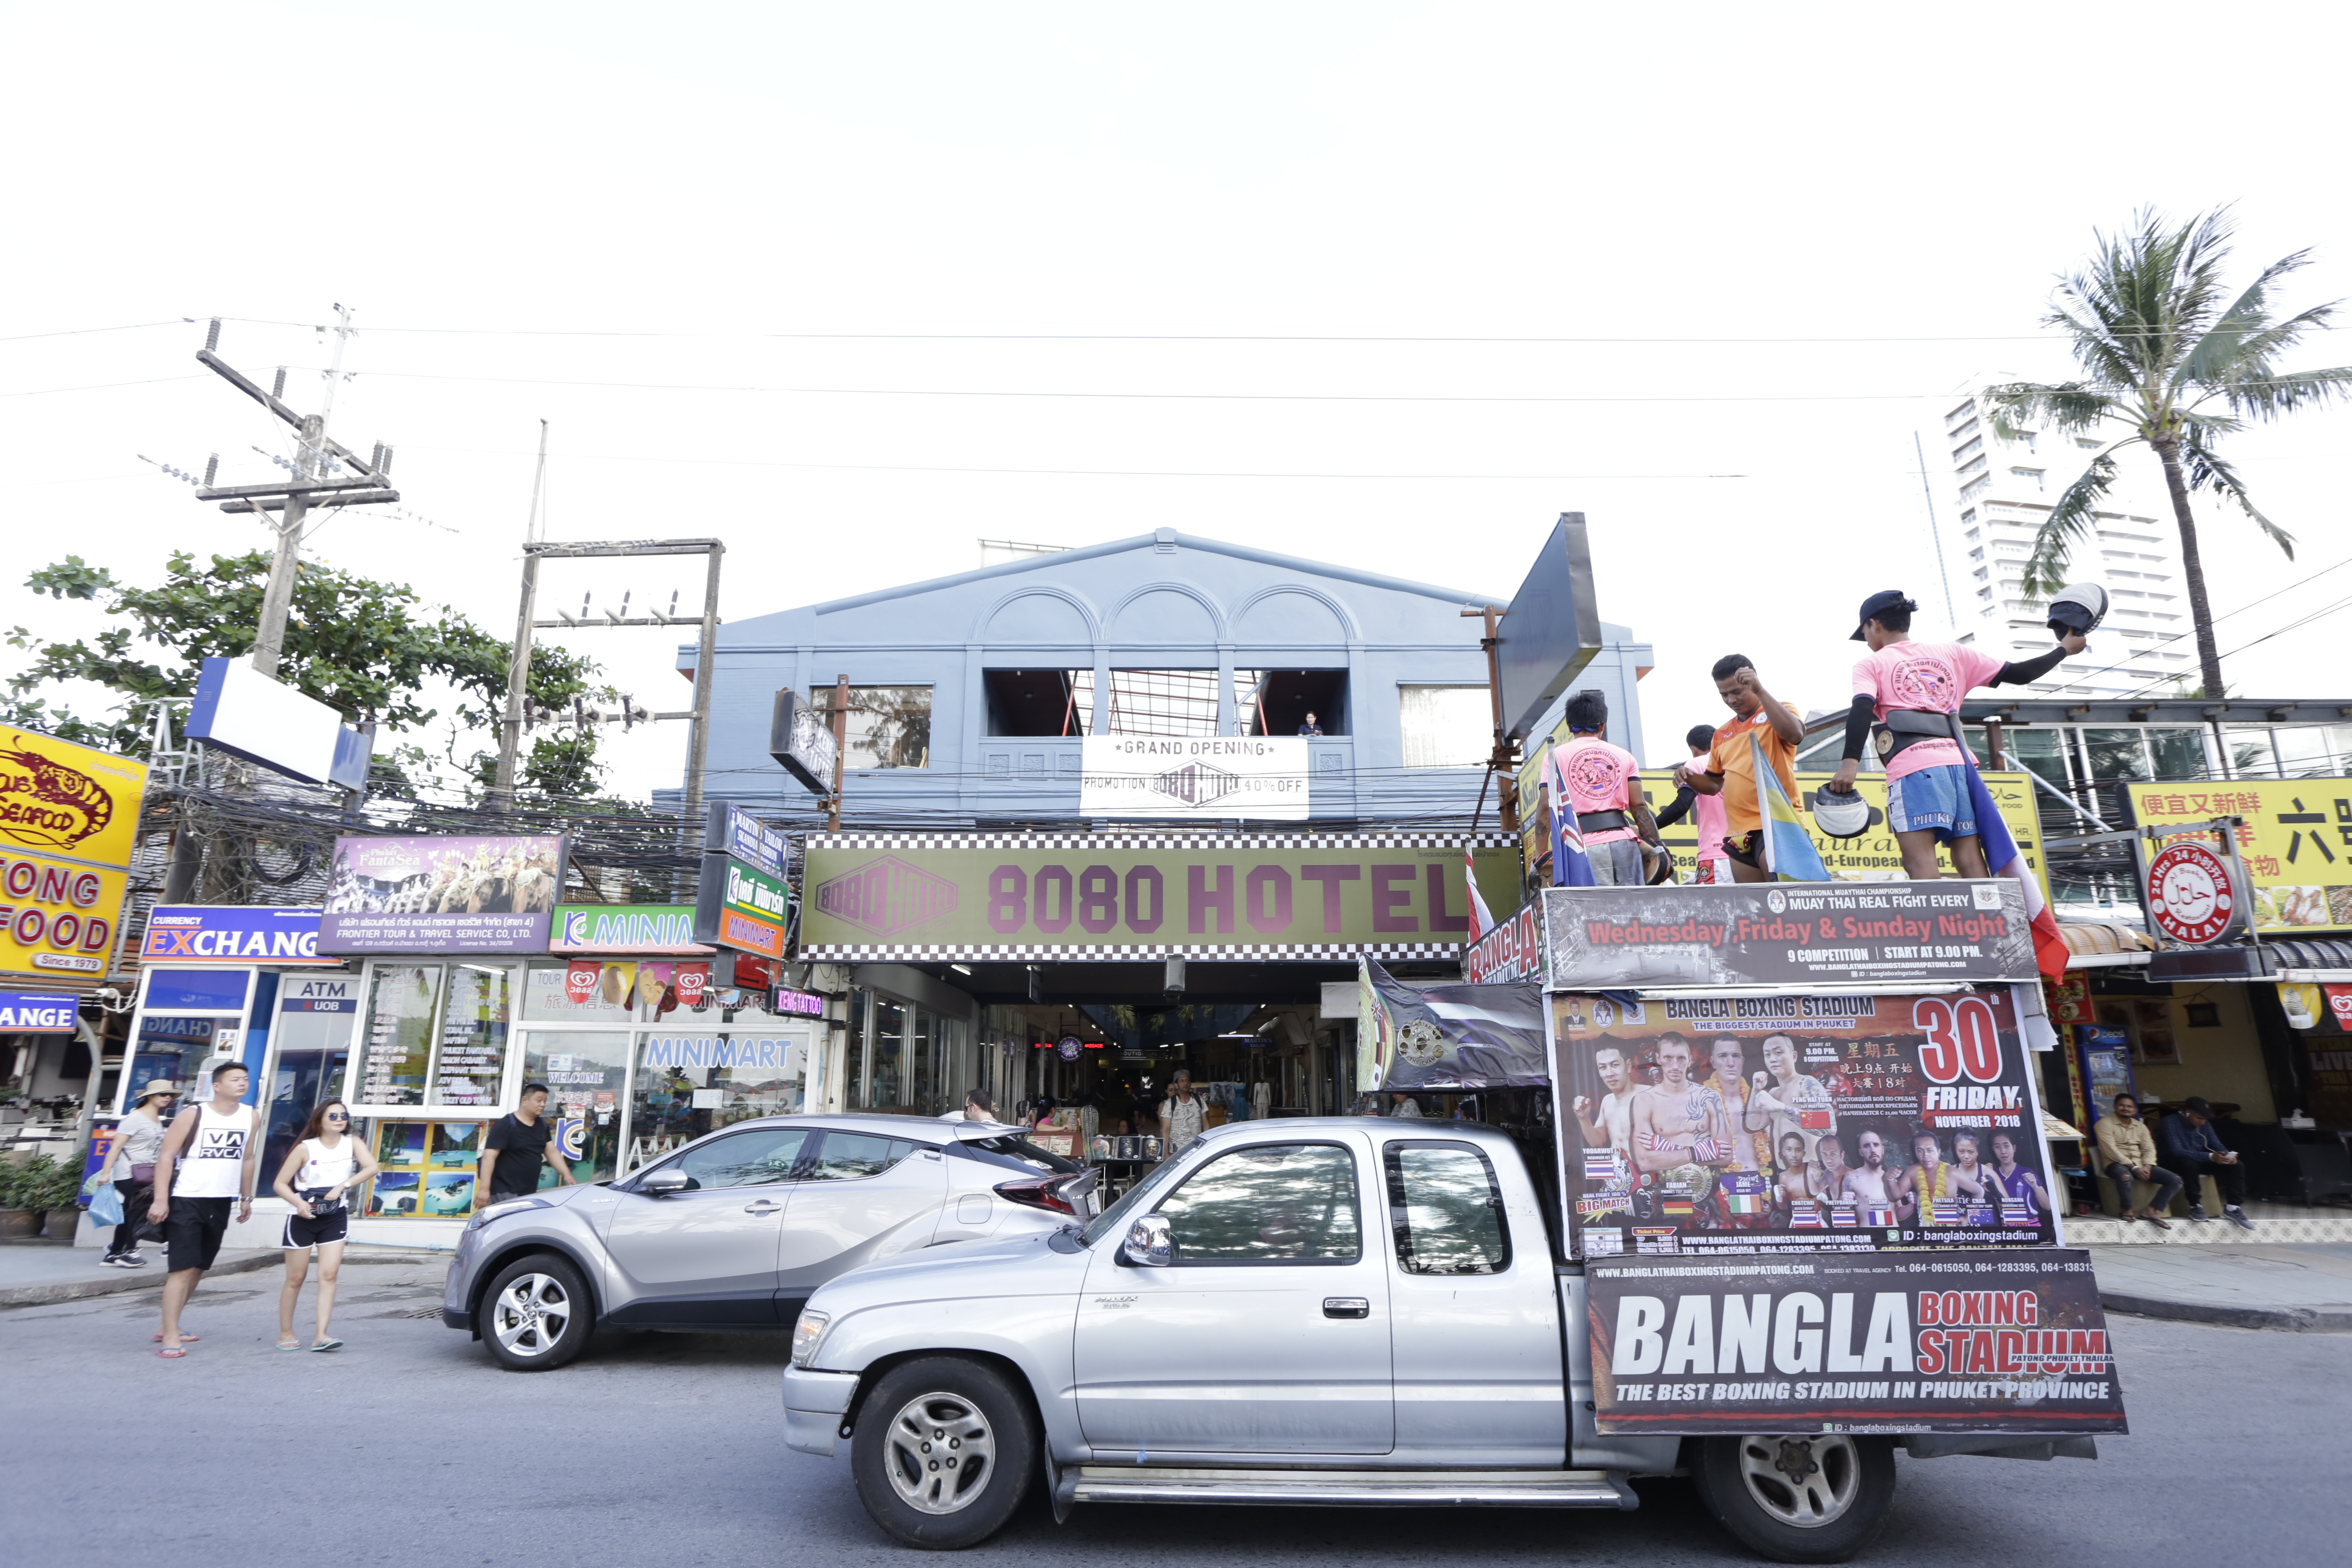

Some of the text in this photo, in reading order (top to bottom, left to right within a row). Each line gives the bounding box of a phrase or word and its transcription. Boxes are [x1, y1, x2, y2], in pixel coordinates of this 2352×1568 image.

[1125, 741, 1264, 756] GRAND OPENING
[1084, 777, 1145, 789] PROMOTION
[1153, 761, 1239, 805] 8080 HOTEL
[1278, 780, 1302, 792] OFF
[1574, 781, 1585, 792] BANGLA
[1599, 788, 1612, 797] STADIUM
[2141, 792, 2261, 816] 便宜又新鮮
[737, 830, 777, 861] SKANDIA FASHION
[764, 830, 782, 851] TAILOR
[359, 854, 420, 866] FantaSea
[2174, 850, 2189, 861] 24
[2152, 860, 2171, 894] 24 Hrs
[820, 859, 954, 933] 8080 HOTEL
[988, 864, 1470, 934] 8080 HOTEL
[1789, 894, 1969, 910] MUAY THAI REAL FIGHT EVERY
[153, 916, 202, 925] CURRENCY
[2163, 916, 2224, 939] HALAL
[337, 930, 380, 938] FRONTIER
[383, 930, 406, 938] TOUR
[409, 930, 416, 938] &
[420, 930, 453, 938] TRAVEL
[456, 930, 493, 938] SERVICE
[514, 930, 531, 938] LTD.
[728, 915, 776, 950] MINIMART
[1588, 922, 1725, 947] Wednesday
[1819, 917, 1837, 940] &
[1844, 915, 1932, 942] Sunday
[1939, 913, 2008, 942] Night
[1469, 905, 1539, 983] BANGLA
[42, 955, 98, 968] Since 1979
[1788, 946, 1983, 962] 9 COMPETITION START AT 9.00 PM.
[1809, 961, 1966, 971] WWW.BANGLATHAIBOXINGSTADIUMPATONG.COM
[538, 974, 561, 985] TOUR
[301, 983, 345, 997] ATM
[314, 1001, 339, 1010] UOB
[1666, 995, 1875, 1020] BANGLA BOXING STADIUM
[1693, 1019, 1856, 1031] THE BIGGEST STADIUM IN PHUKET
[1912, 993, 2003, 1084] 30 th
[2102, 1029, 2125, 1040] pepsi
[646, 1037, 792, 1069] MINIMART
[1847, 1041, 1900, 1059] 星期五
[1840, 1063, 1913, 1074] 晚上9点 开始
[548, 1072, 603, 1083] WELCOME
[1853, 1077, 1906, 1088] 大赛 8对
[554, 1091, 593, 1103] 欢迎光临
[1926, 1086, 2020, 1110] FRIDAY
[1935, 1115, 2021, 1128] NOVEMBER 2018
[200, 1148, 242, 1158] RVCA
[1576, 1198, 1630, 1214] BIG MATCH
[1682, 1235, 1871, 1245] WWW.BANGLATHAIBOXINGSTADIUMPATONG.COM
[1903, 1230, 2038, 1243] ID banglaboxingstadium
[1596, 1265, 1814, 1277] WWW.BANGLATHAIBOXINGSTADIUMPATONG.COM
[1909, 1263, 1972, 1274] 064-0615050,
[1975, 1263, 2039, 1273] 064-1283395,
[1918, 1290, 2037, 1326] BOXING
[1611, 1292, 1914, 1375] BANGLA
[1917, 1329, 2106, 1375] STADIUM
[1616, 1381, 2109, 1401] THE BEST BOXING STADIUM IN PHUKET PROVINCE
[1850, 1424, 1931, 1433] banglaboxingstadium
